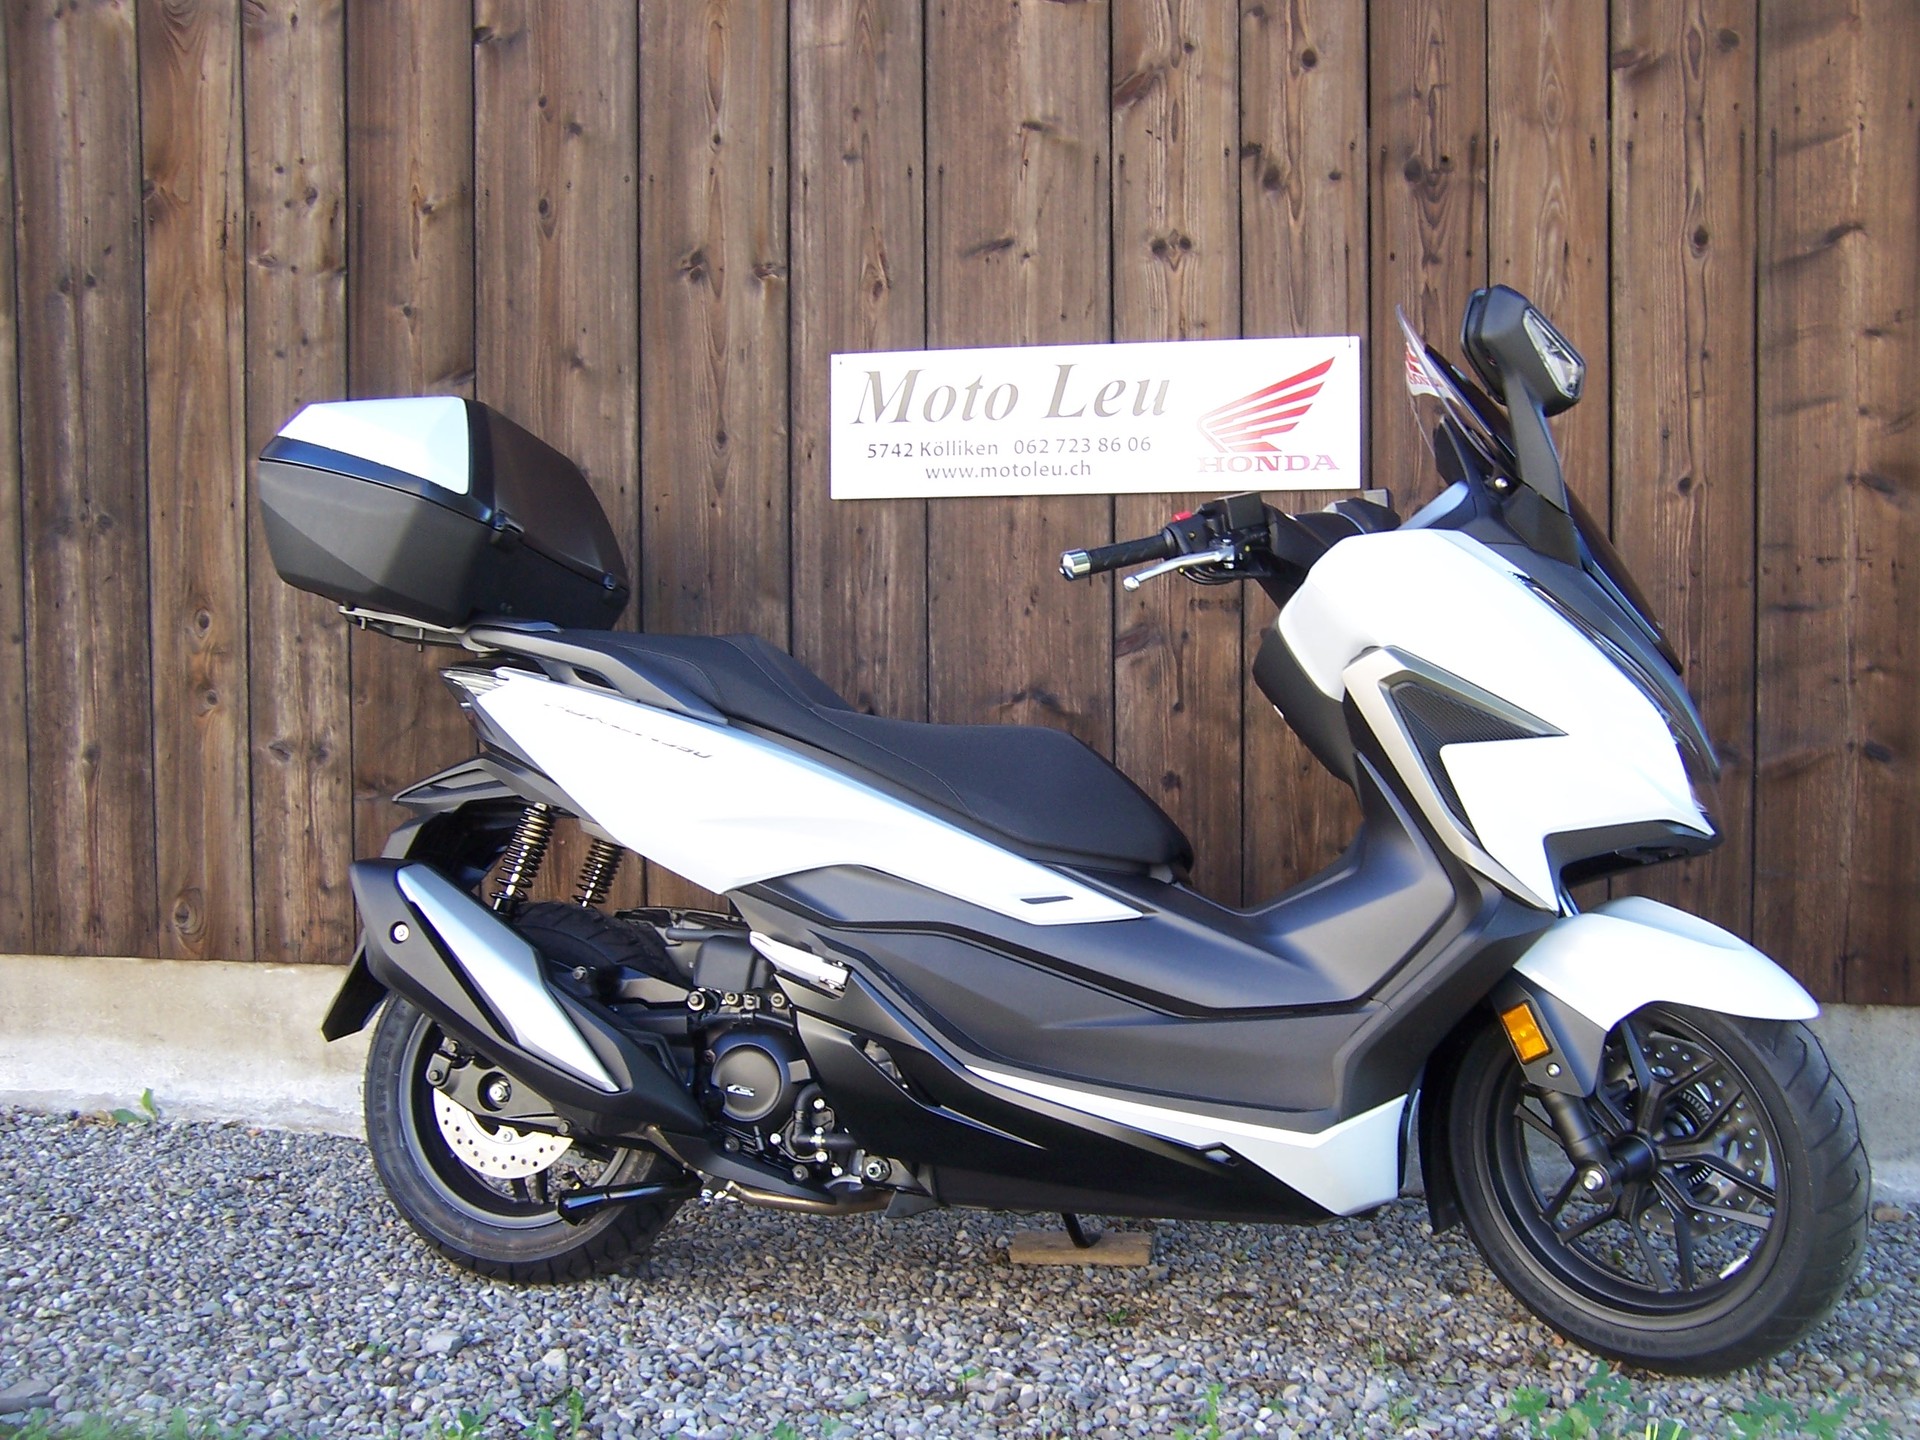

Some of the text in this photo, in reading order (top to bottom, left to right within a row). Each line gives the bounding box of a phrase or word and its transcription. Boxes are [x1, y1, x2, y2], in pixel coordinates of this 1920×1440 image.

[849, 363, 1170, 424] Moto Leu
[867, 436, 1151, 458] 5742 Kölliken 062 723 86 06
[925, 459, 1092, 480] www.motoleu.ch
[1197, 454, 1340, 473] HONDA
